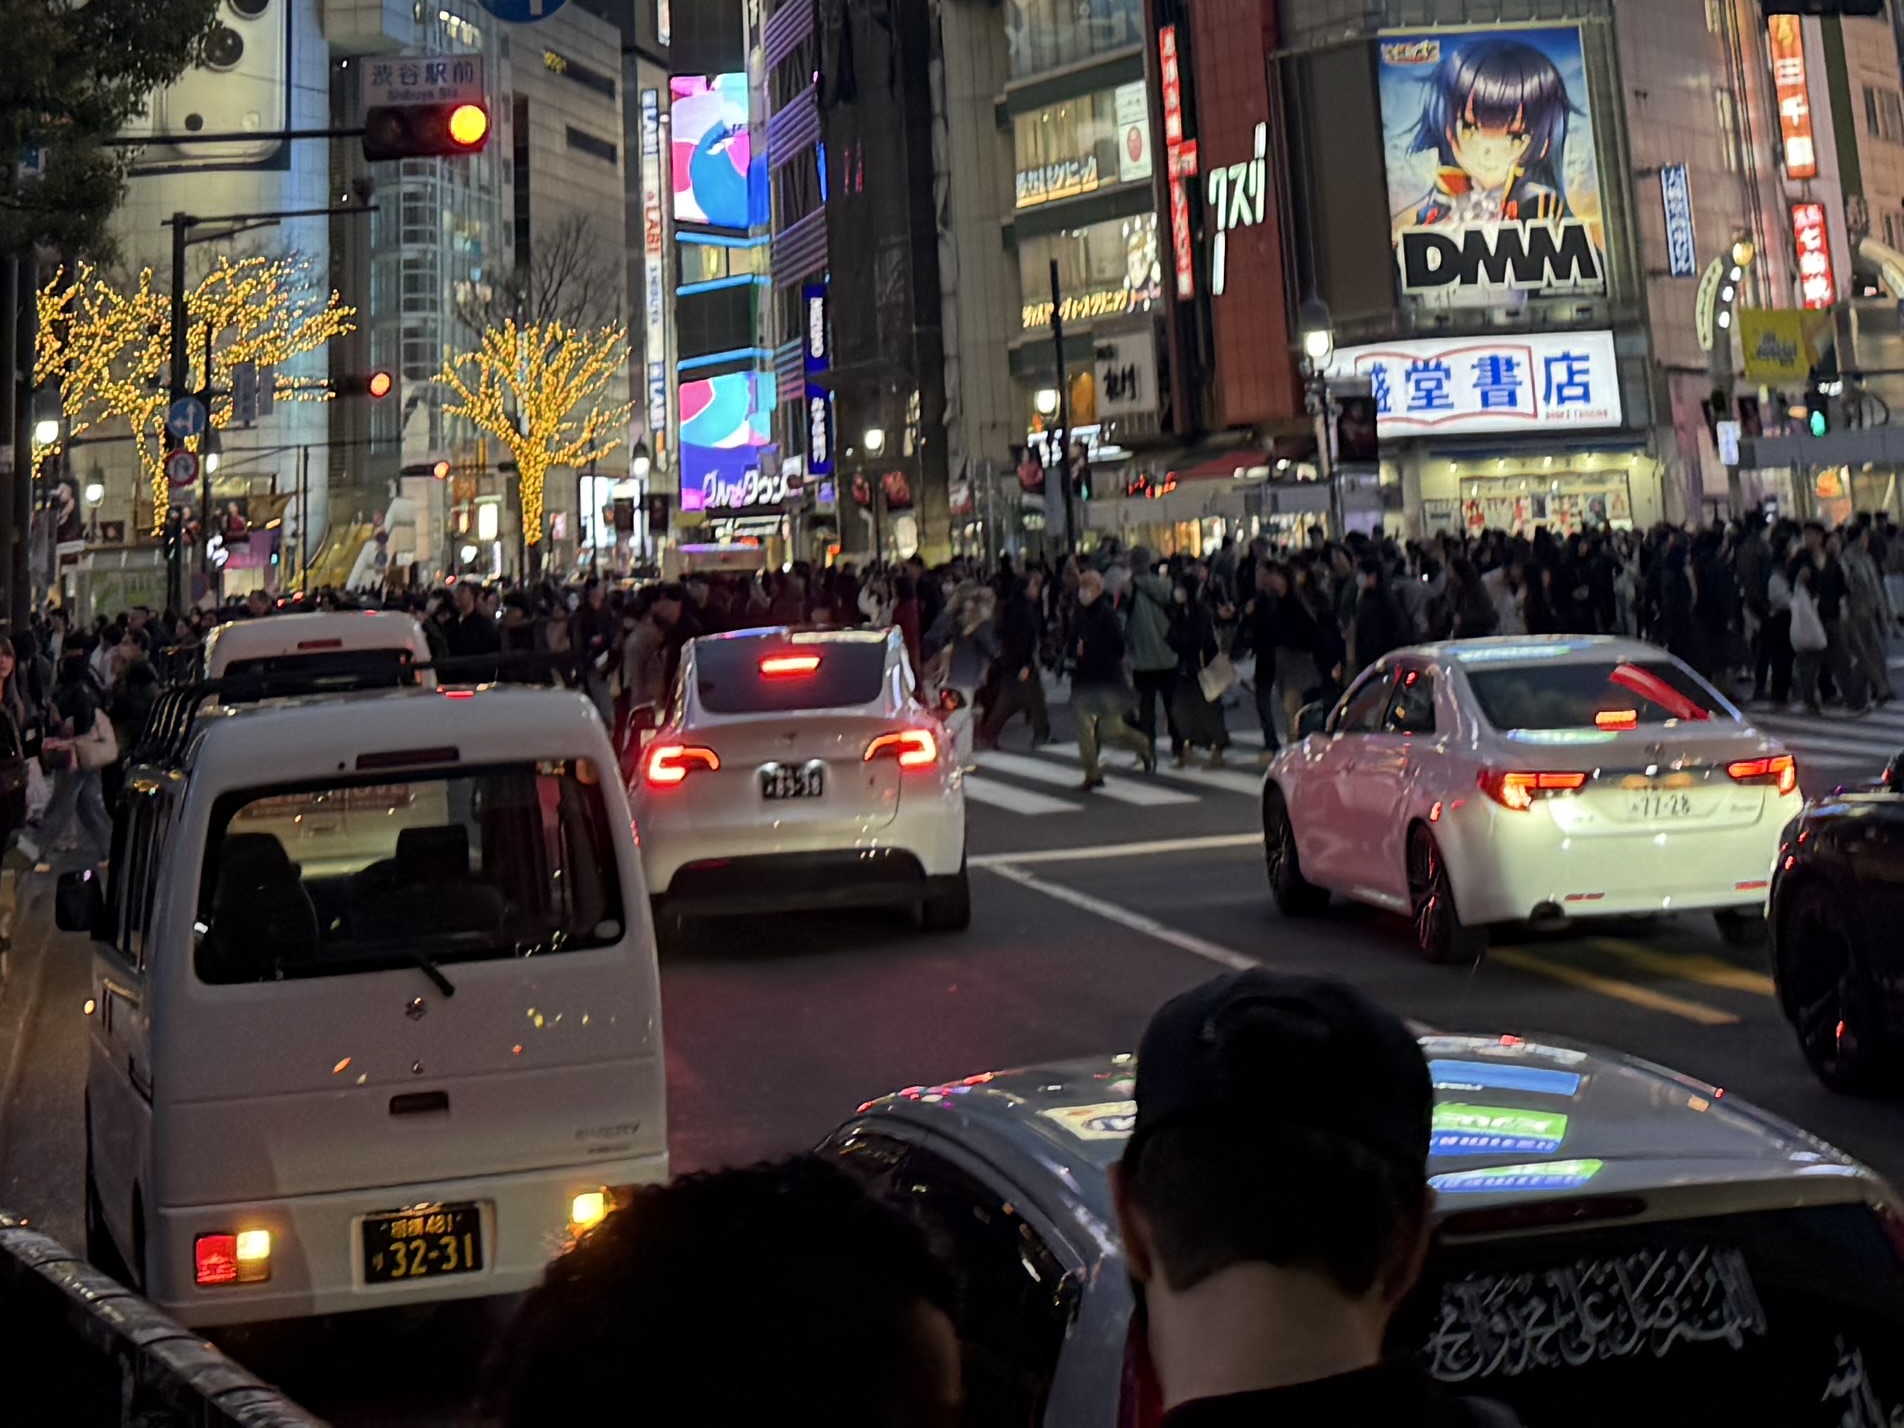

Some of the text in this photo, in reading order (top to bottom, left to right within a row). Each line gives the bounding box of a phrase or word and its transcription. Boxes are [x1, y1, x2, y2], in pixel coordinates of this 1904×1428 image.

[371, 61, 474, 87] 渋谷駅前
[1403, 223, 1599, 287] DMM
[389, 1232, 474, 1278] 32-31
